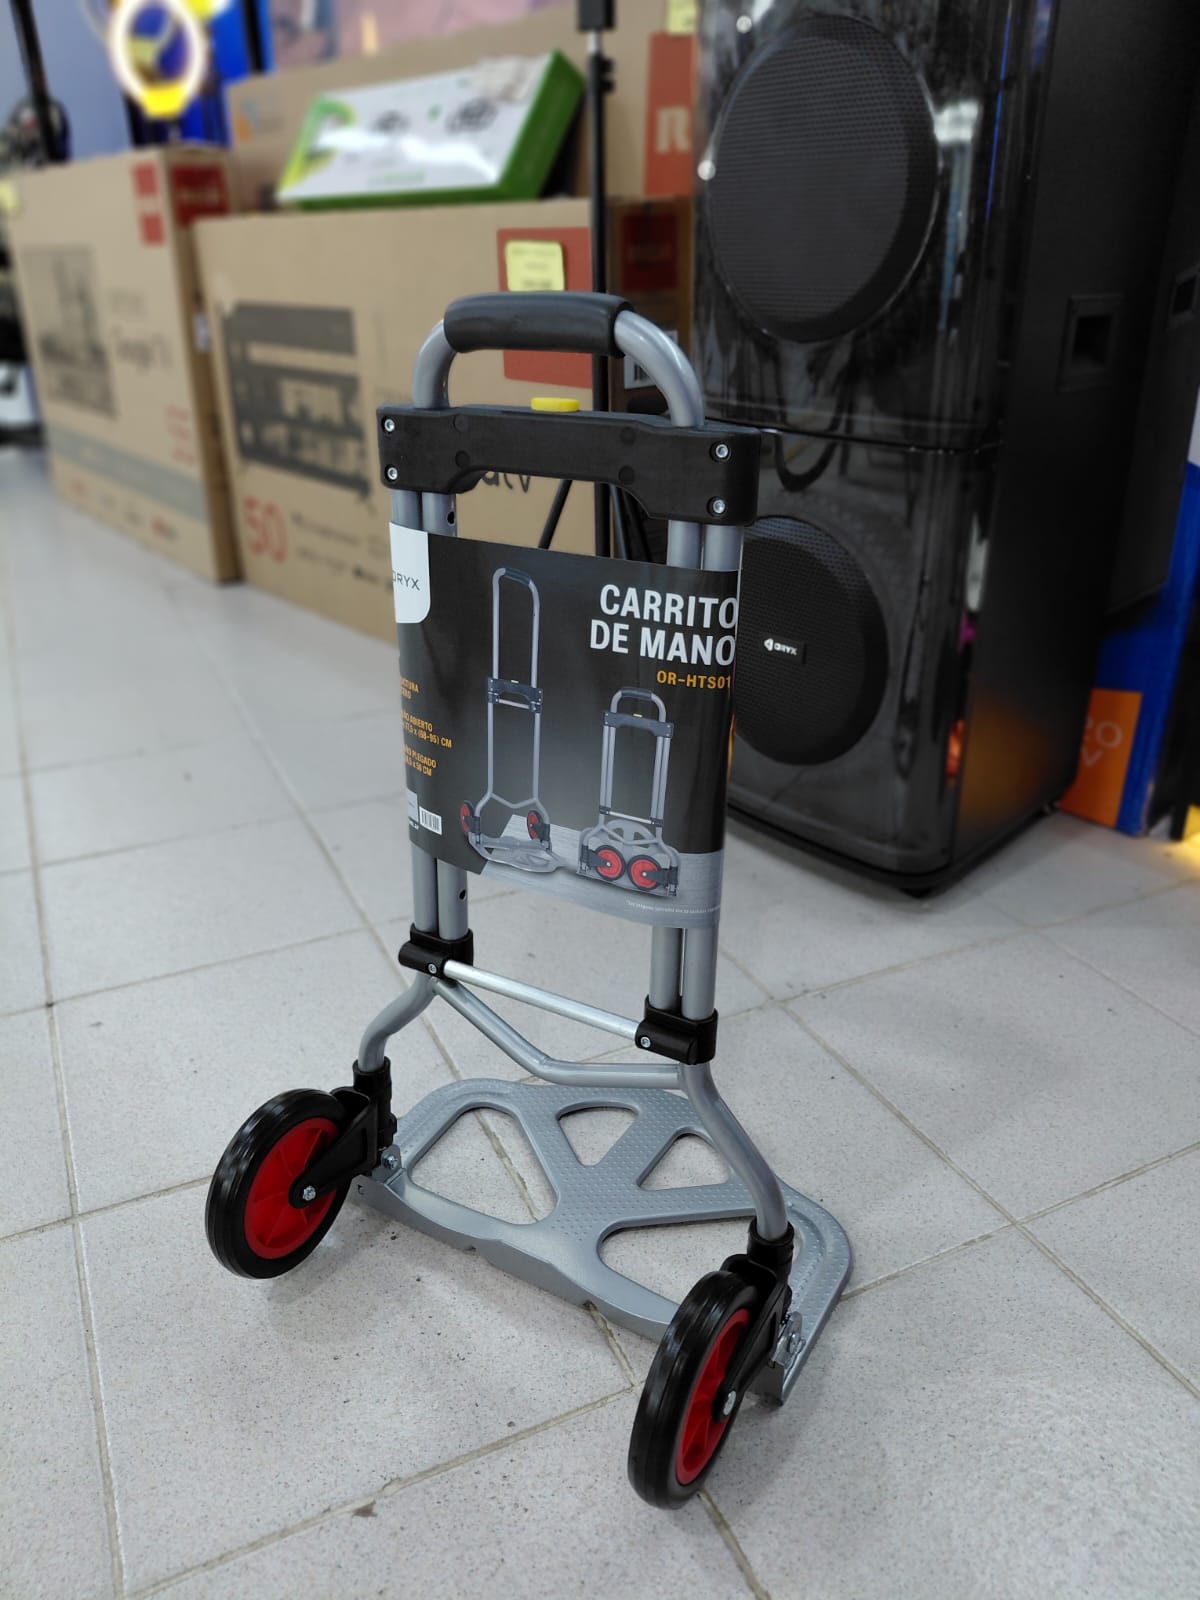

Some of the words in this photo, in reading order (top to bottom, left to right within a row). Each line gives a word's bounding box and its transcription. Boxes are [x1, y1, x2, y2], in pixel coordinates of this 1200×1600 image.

[600, 584, 739, 629] CARRITO
[590, 619, 630, 654] DE
[640, 627, 736, 666] MANO
[656, 670, 732, 689] OR-HTS01
[441, 737, 453, 748] CM
[423, 765, 433, 776] CM
